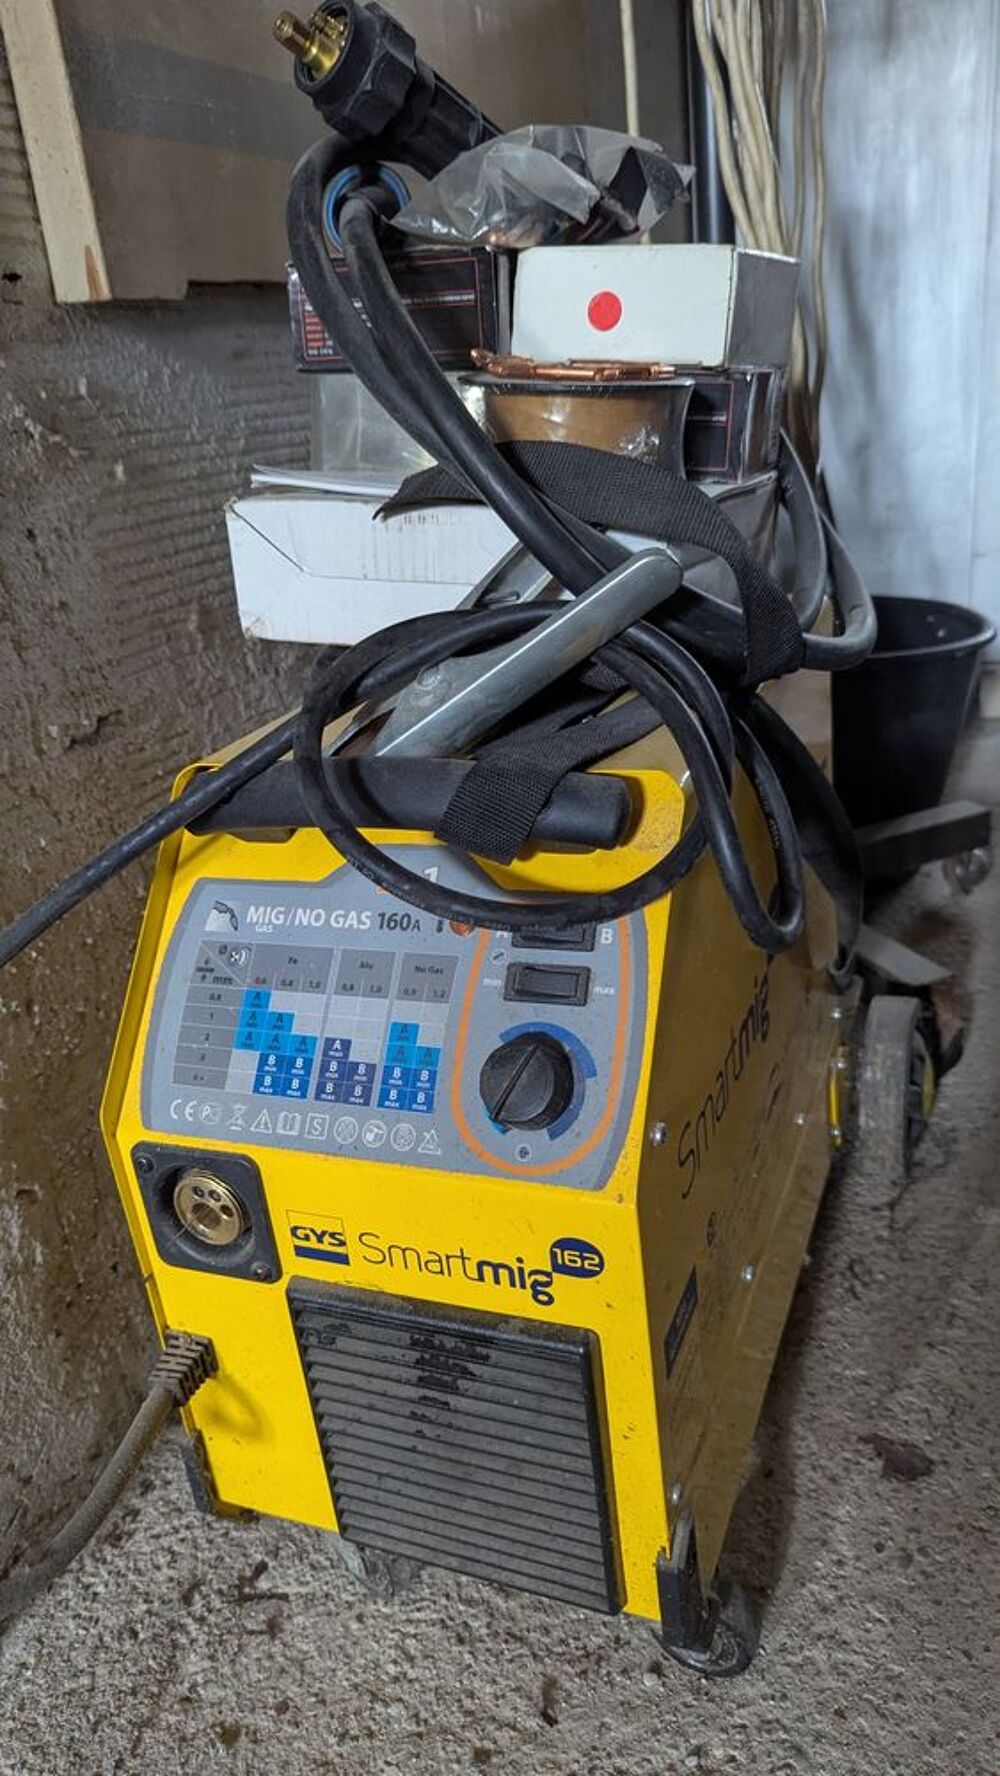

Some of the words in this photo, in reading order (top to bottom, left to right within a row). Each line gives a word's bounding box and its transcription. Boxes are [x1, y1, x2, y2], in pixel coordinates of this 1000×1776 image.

[330, 910, 371, 930] GAS
[255, 924, 273, 933] GAS
[600, 928, 613, 944] B
[332, 1040, 341, 1050] A
[268, 1055, 276, 1064] B
[295, 1058, 304, 1068] B
[330, 1061, 338, 1072] B
[358, 1063, 366, 1075] B
[393, 1067, 402, 1078] B
[420, 1070, 429, 1081] B
[264, 1076, 272, 1086] B
[291, 1079, 300, 1089] B
[326, 1082, 335, 1093] B
[354, 1084, 363, 1096] B
[389, 1089, 398, 1100] B
[416, 1091, 426, 1104] B
[290, 1224, 347, 1247] GYS
[358, 1232, 555, 1306] Smartmig
[552, 1246, 600, 1271] 162
